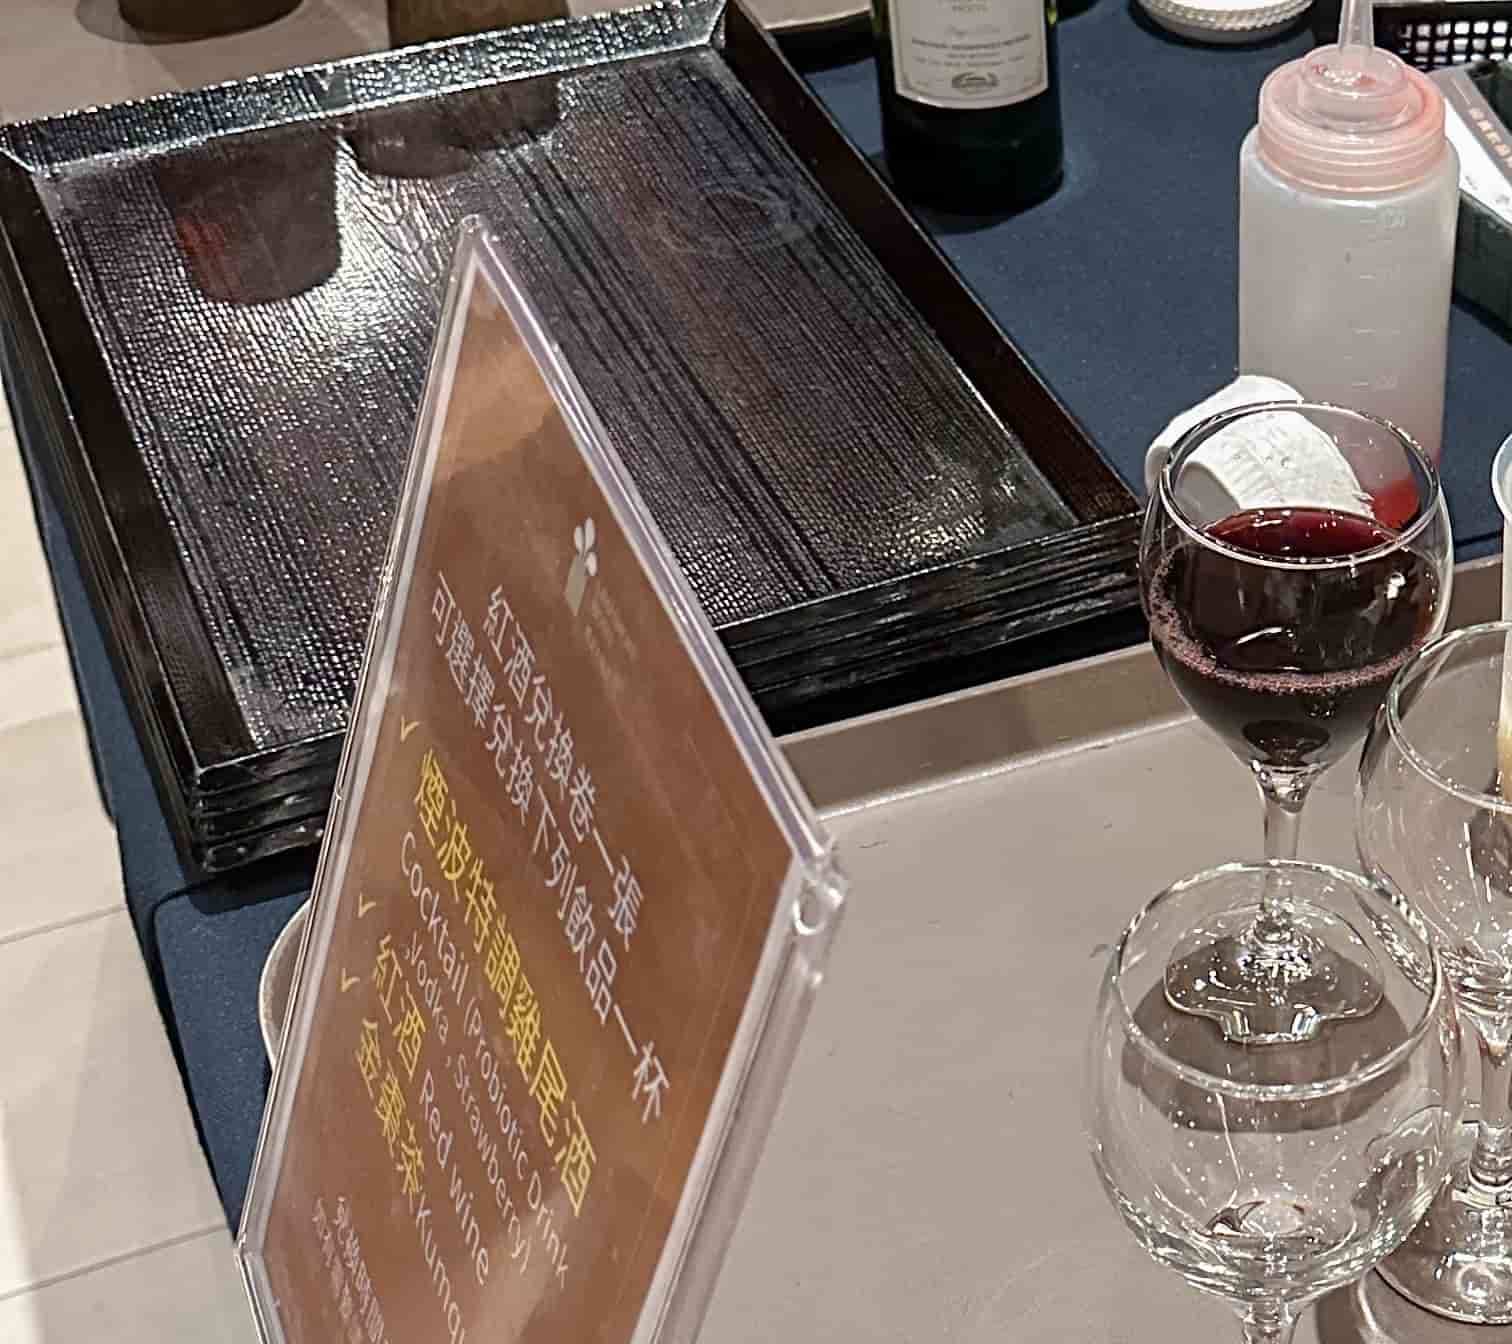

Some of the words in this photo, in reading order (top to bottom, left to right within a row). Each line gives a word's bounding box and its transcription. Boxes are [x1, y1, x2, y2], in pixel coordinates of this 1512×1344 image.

[413, 747, 596, 1218] 煙波特調雞尾酒
[431, 570, 670, 1124] 可選擇兌換下列飲品一杯
[482, 584, 644, 952] 紅酒兌換卷一張
[370, 933, 426, 1082] 紅酒
[418, 1068, 453, 1171] Red
[449, 1162, 488, 1285] wine
[400, 829, 469, 1005] Cocktail
[463, 996, 528, 1180] (Probiotic
[527, 1170, 568, 1288] Drink
